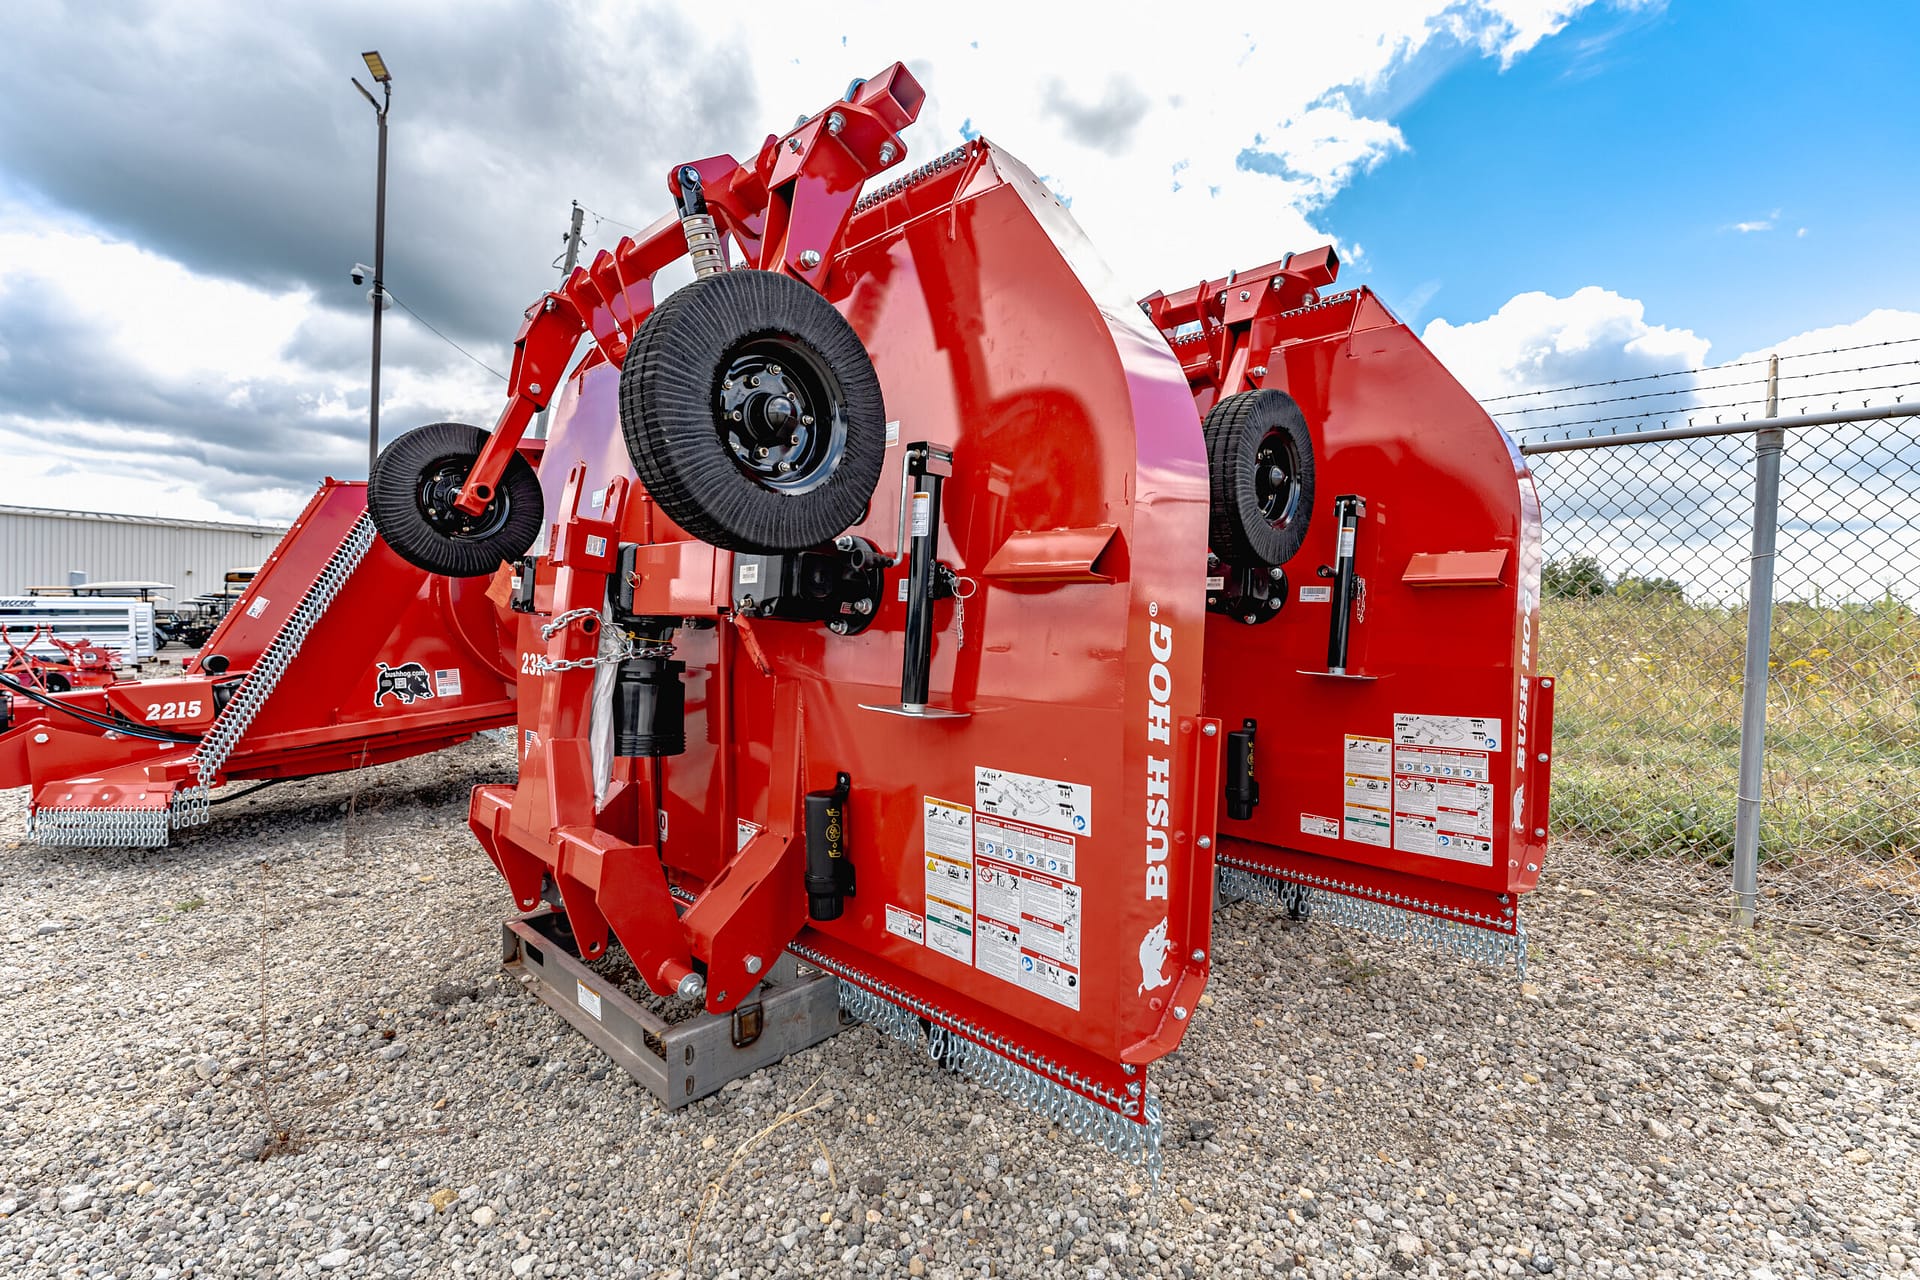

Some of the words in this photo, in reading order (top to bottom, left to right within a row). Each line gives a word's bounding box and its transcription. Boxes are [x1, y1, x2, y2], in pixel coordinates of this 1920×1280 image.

[384, 670, 425, 679] bushhog.com
[145, 700, 202, 721] 2215
[1516, 673, 1530, 772] BUSH
[1146, 755, 1169, 901] BUSH
